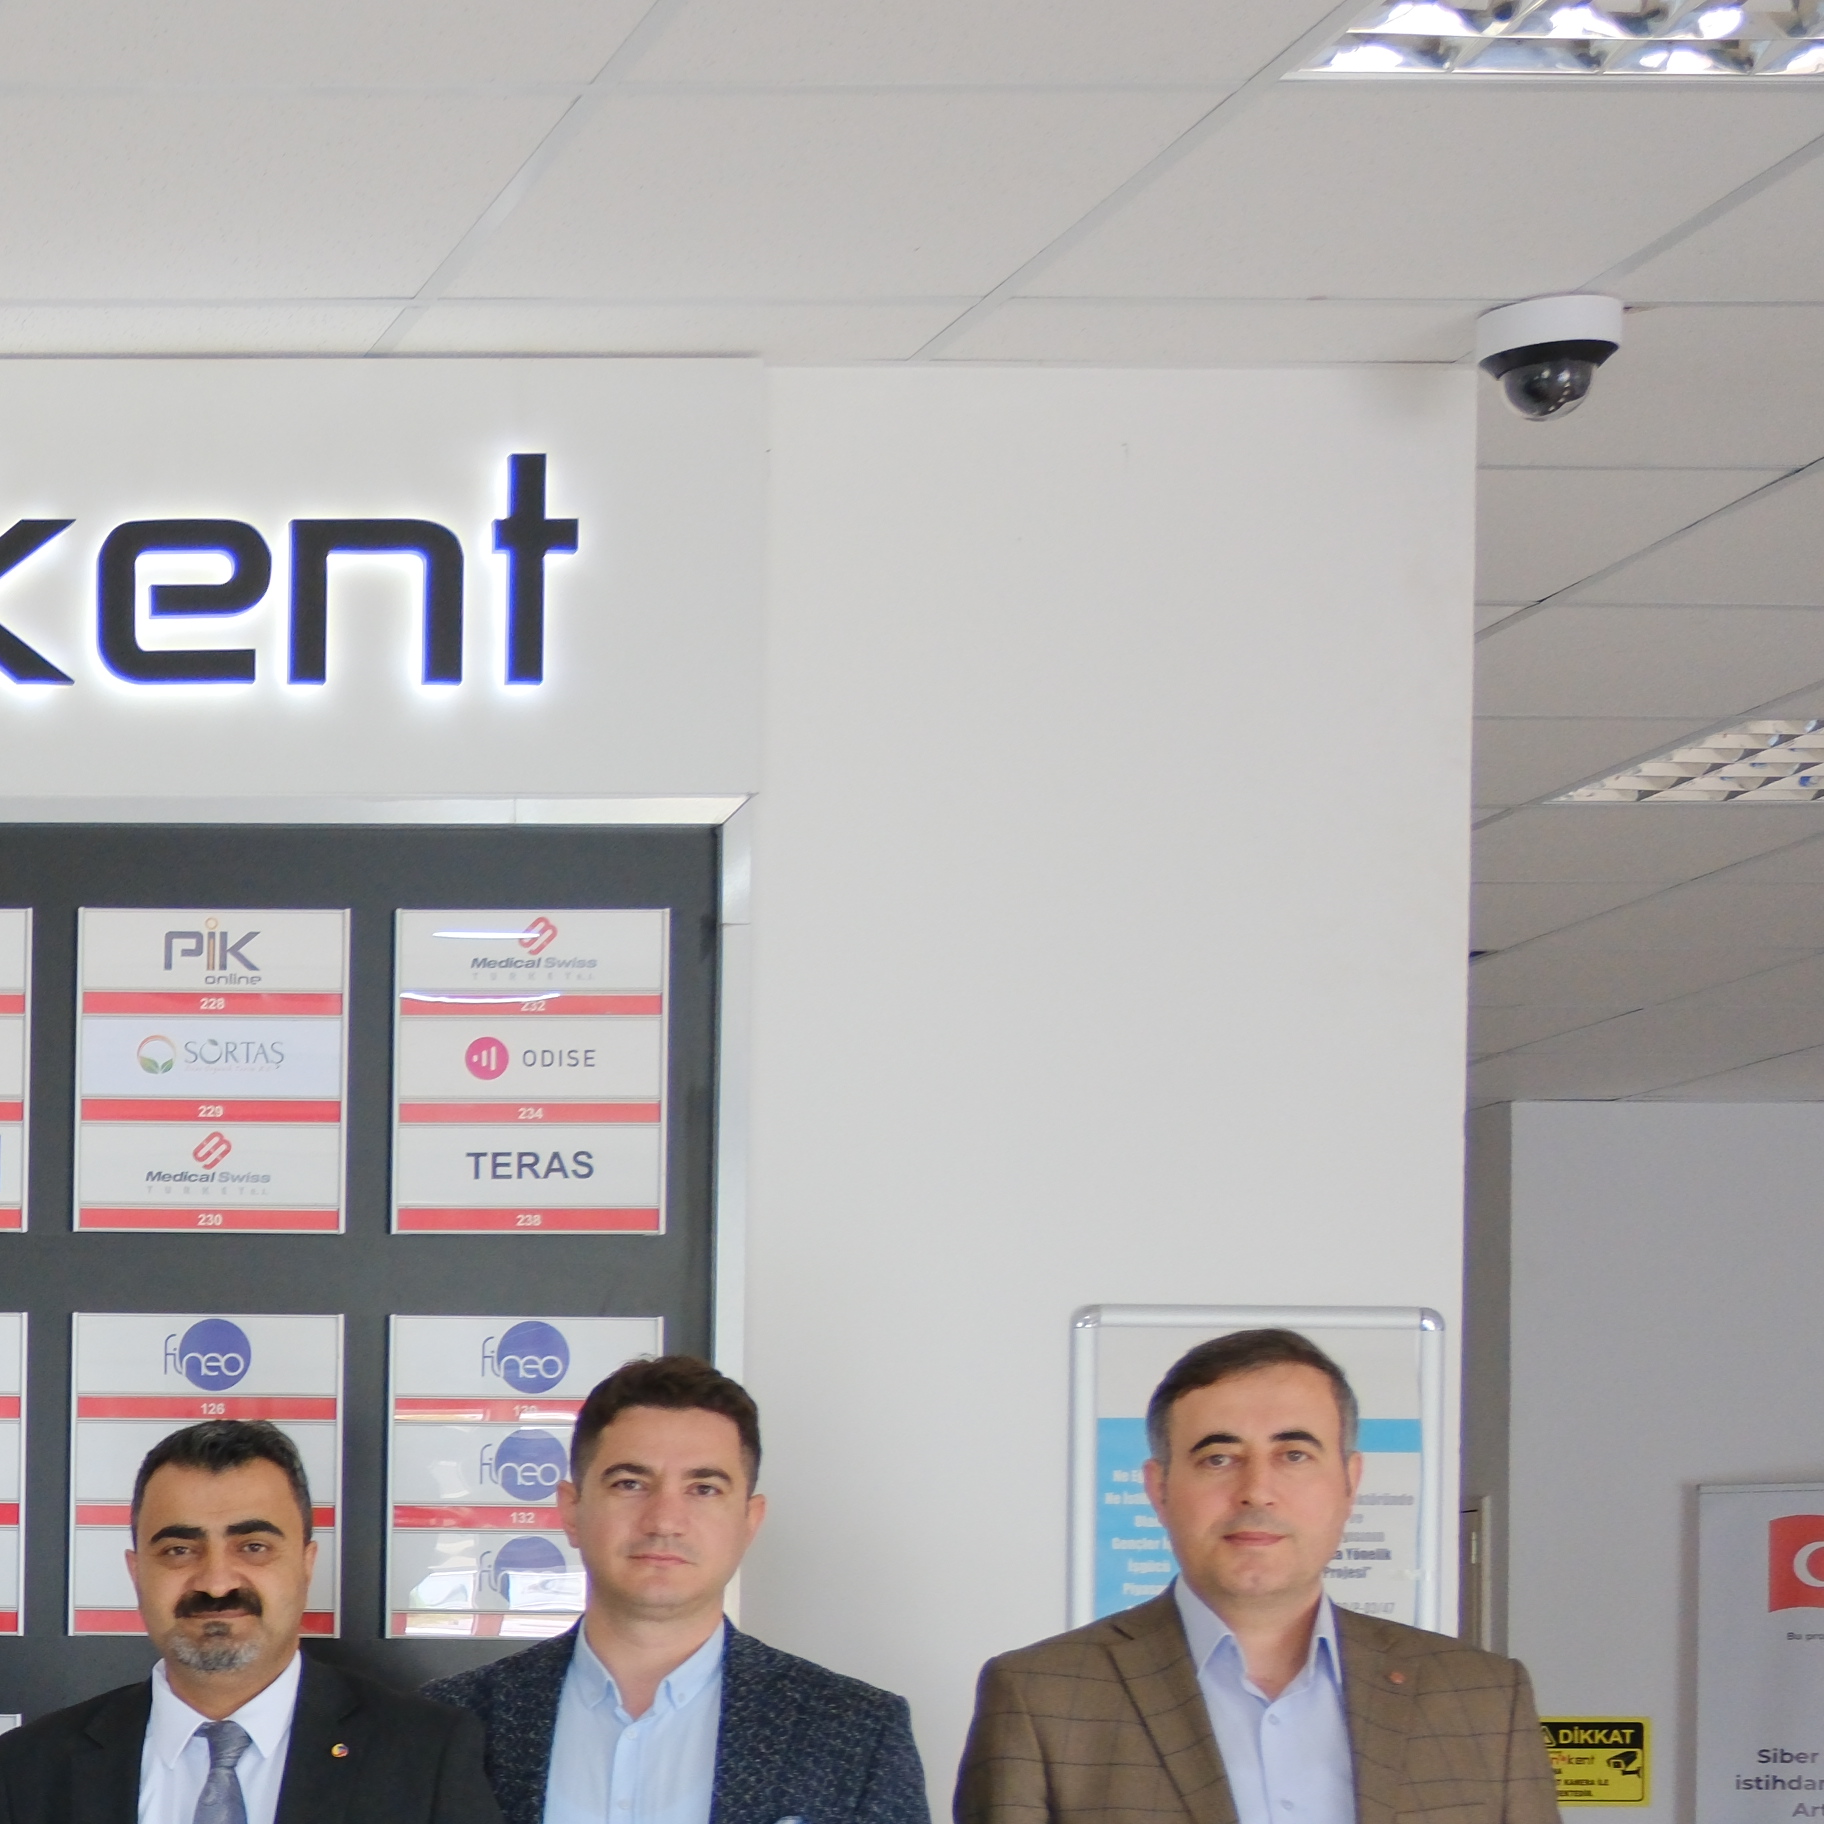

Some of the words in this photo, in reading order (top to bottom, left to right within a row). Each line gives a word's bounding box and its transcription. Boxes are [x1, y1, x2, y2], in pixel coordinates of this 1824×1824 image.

[471, 957, 542, 968] Medical
[544, 957, 598, 968] Swiss
[205, 973, 262, 985] online
[200, 998, 225, 1010] 228
[523, 1050, 596, 1067] ODISE
[198, 1104, 224, 1118] 229
[518, 1106, 544, 1120] 234
[466, 1151, 595, 1180] TERAS
[145, 1171, 215, 1182] Medical
[218, 1171, 271, 1183] Swiss
[197, 1214, 222, 1225] 230
[200, 1402, 225, 1416] 126
[511, 1512, 535, 1524] 132
[1559, 1726, 1635, 1744] DİKKAT
[1757, 1748, 1819, 1764] Siber
